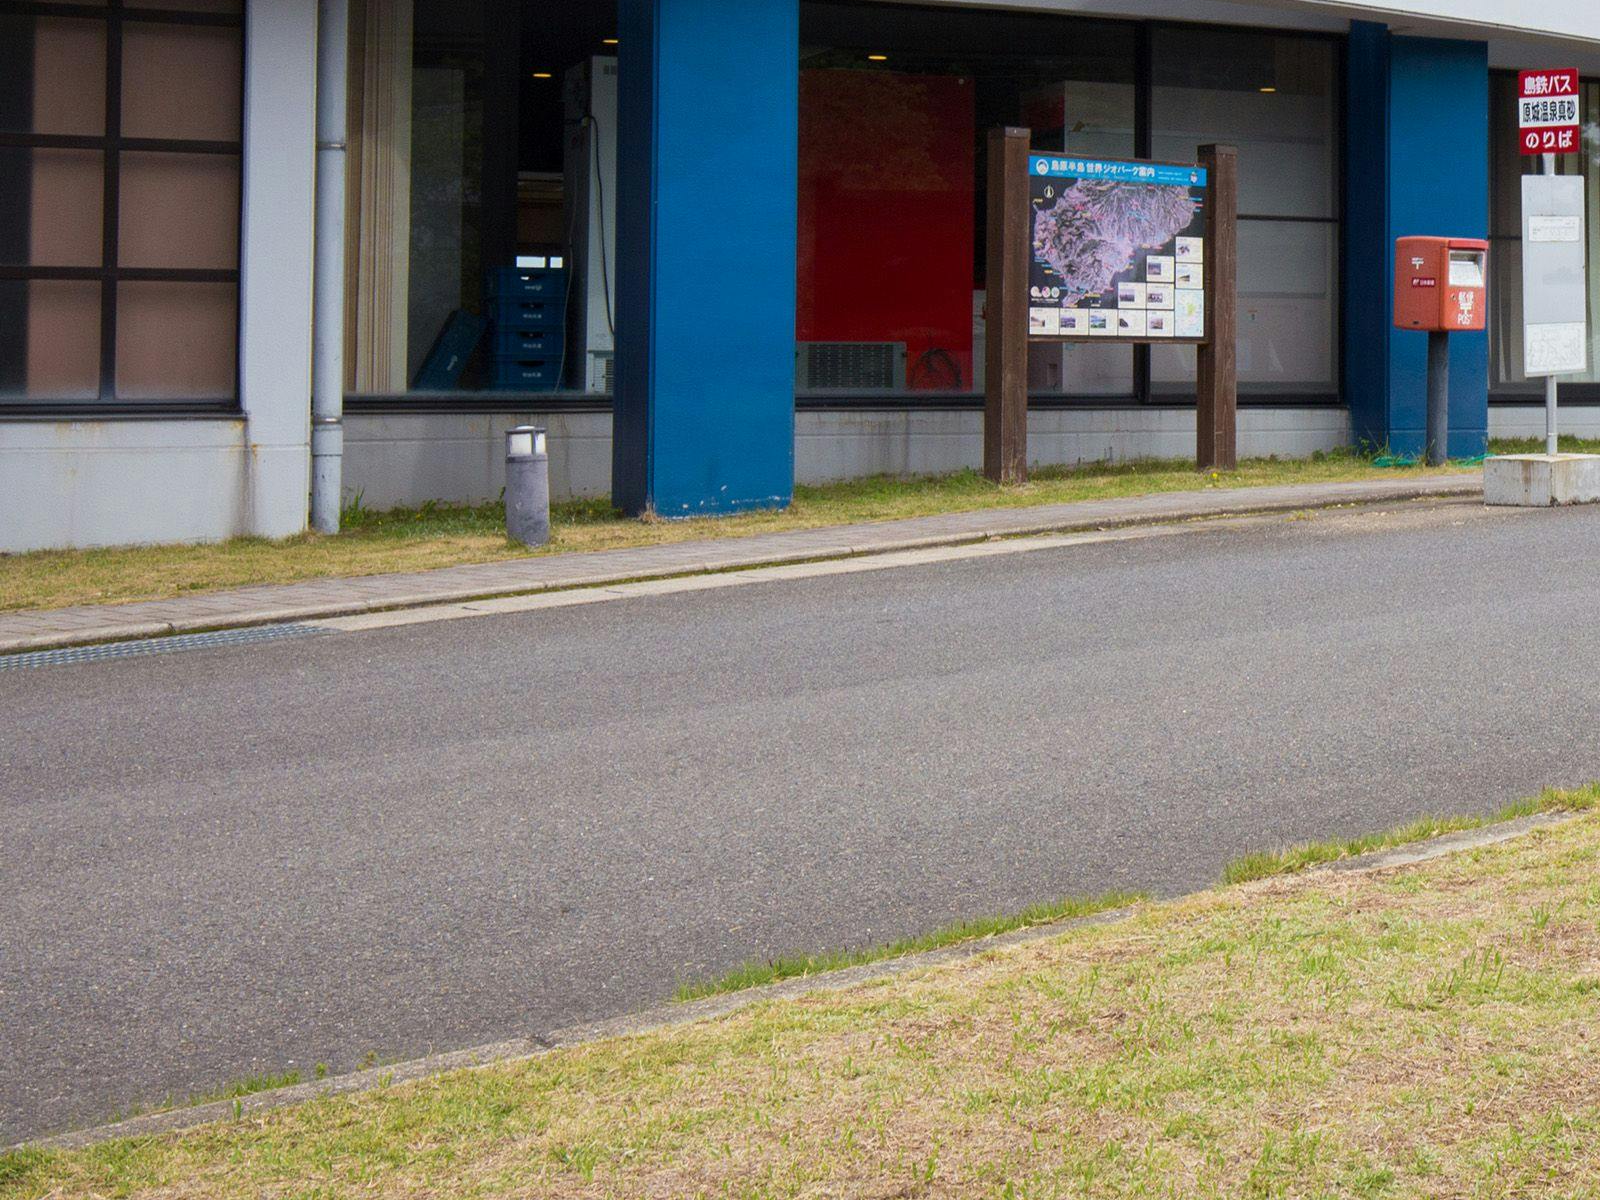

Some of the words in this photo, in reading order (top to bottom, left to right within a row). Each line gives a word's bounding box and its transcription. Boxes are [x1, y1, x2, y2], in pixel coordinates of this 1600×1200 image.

[1524, 75, 1572, 95] 島鉄バス
[1523, 100, 1576, 122] 原城温泉真砂
[1525, 130, 1573, 149] のりば
